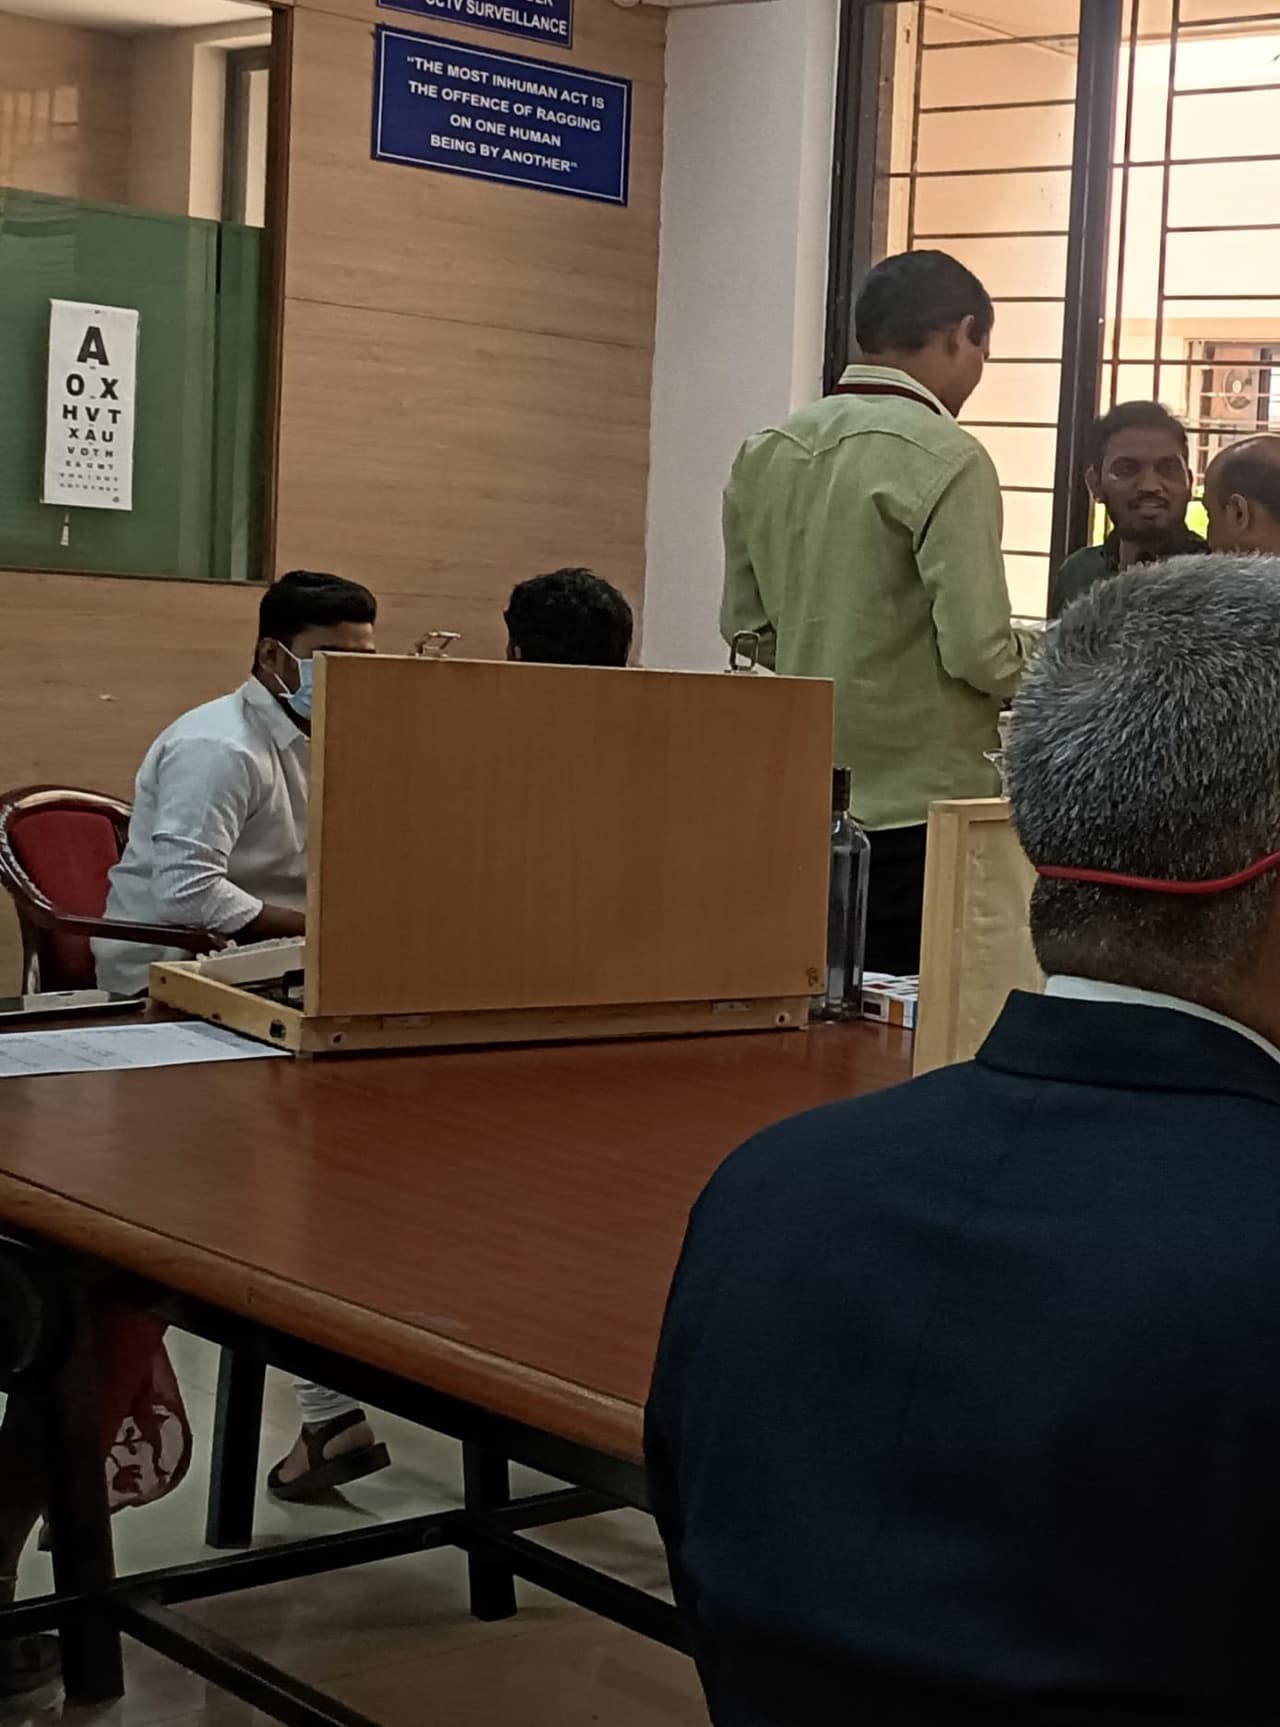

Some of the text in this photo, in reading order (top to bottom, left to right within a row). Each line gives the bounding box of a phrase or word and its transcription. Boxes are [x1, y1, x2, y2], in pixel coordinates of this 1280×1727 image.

[466, 0, 568, 35] SURVEILLANCE
[447, 65, 489, 84] MOST
[492, 74, 558, 99] INHUMAN
[560, 90, 588, 105] ACT
[592, 96, 605, 109] IS
[408, 80, 601, 132] THE OFFENCE OF RAGGING
[450, 114, 561, 147] ON ONE HUMAN
[430, 134, 577, 172] BEING BY ANOTHER"
[76, 326, 110, 366] A
[66, 373, 119, 400] O X
[62, 404, 122, 424] H V T
